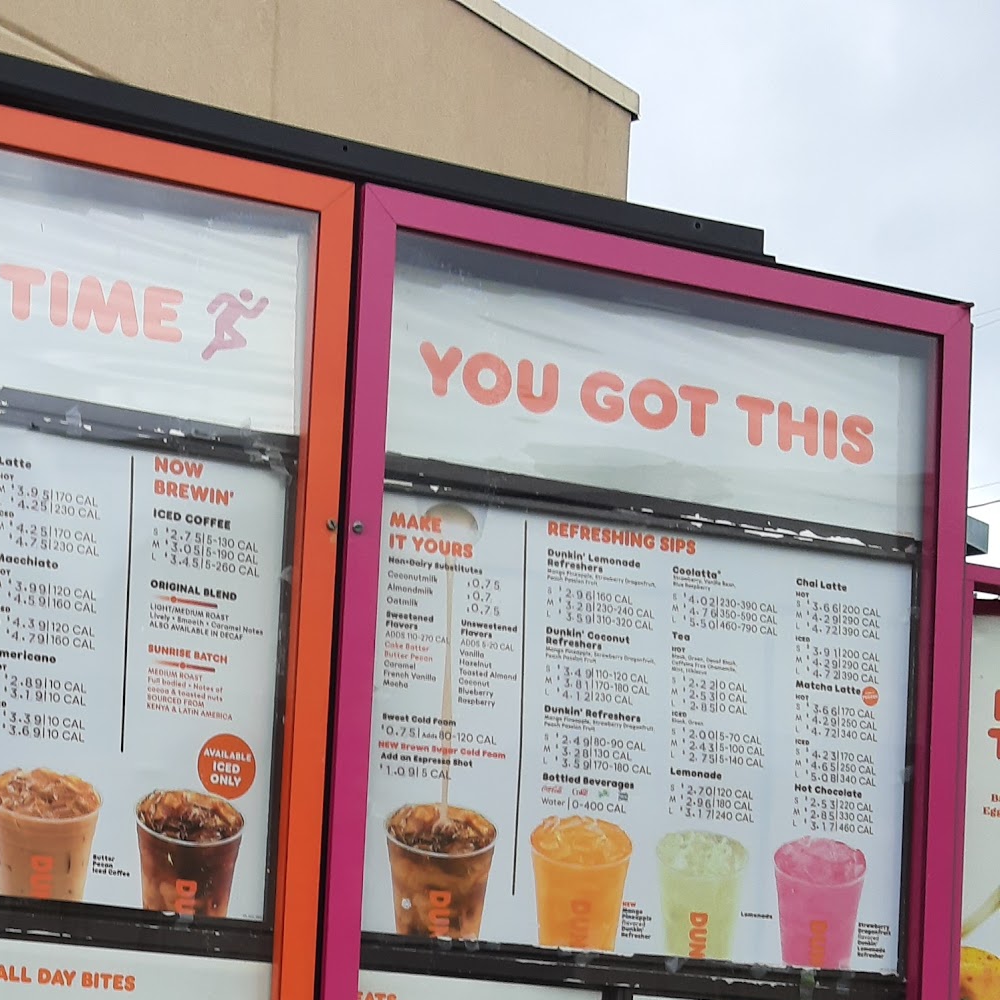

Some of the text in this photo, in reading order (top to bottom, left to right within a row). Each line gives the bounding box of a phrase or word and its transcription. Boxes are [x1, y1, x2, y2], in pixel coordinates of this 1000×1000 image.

[419, 340, 875, 466] YOU GOT THIS
[154, 456, 204, 478] NOW
[154, 479, 234, 506] BREWIN'
[153, 508, 231, 531] ICED COFFEE
[389, 511, 442, 534] MAKE
[389, 533, 474, 559] IT YOURS
[547, 520, 696, 555] REFRESHING SIPS
[547, 559, 604, 574] Refreshers
[588, 553, 641, 569] Lemonade
[387, 570, 438, 584] Coconutmilk
[796, 578, 847, 592] Chai Latte
[150, 580, 238, 601] ORIGINAL BLEND
[461, 619, 517, 633] Unsweetened
[148, 644, 228, 664] SUNRISE BATCH
[795, 680, 861, 696] Matcha Latte
[203, 747, 252, 762] AVAILABLE
[213, 761, 241, 774] ICED
[670, 767, 722, 781] Lemonade
[210, 774, 242, 788] ONLY
[543, 773, 634, 791] Bottled Beverages
[38, 968, 77, 986] DAY
[81, 972, 136, 992] BITES
